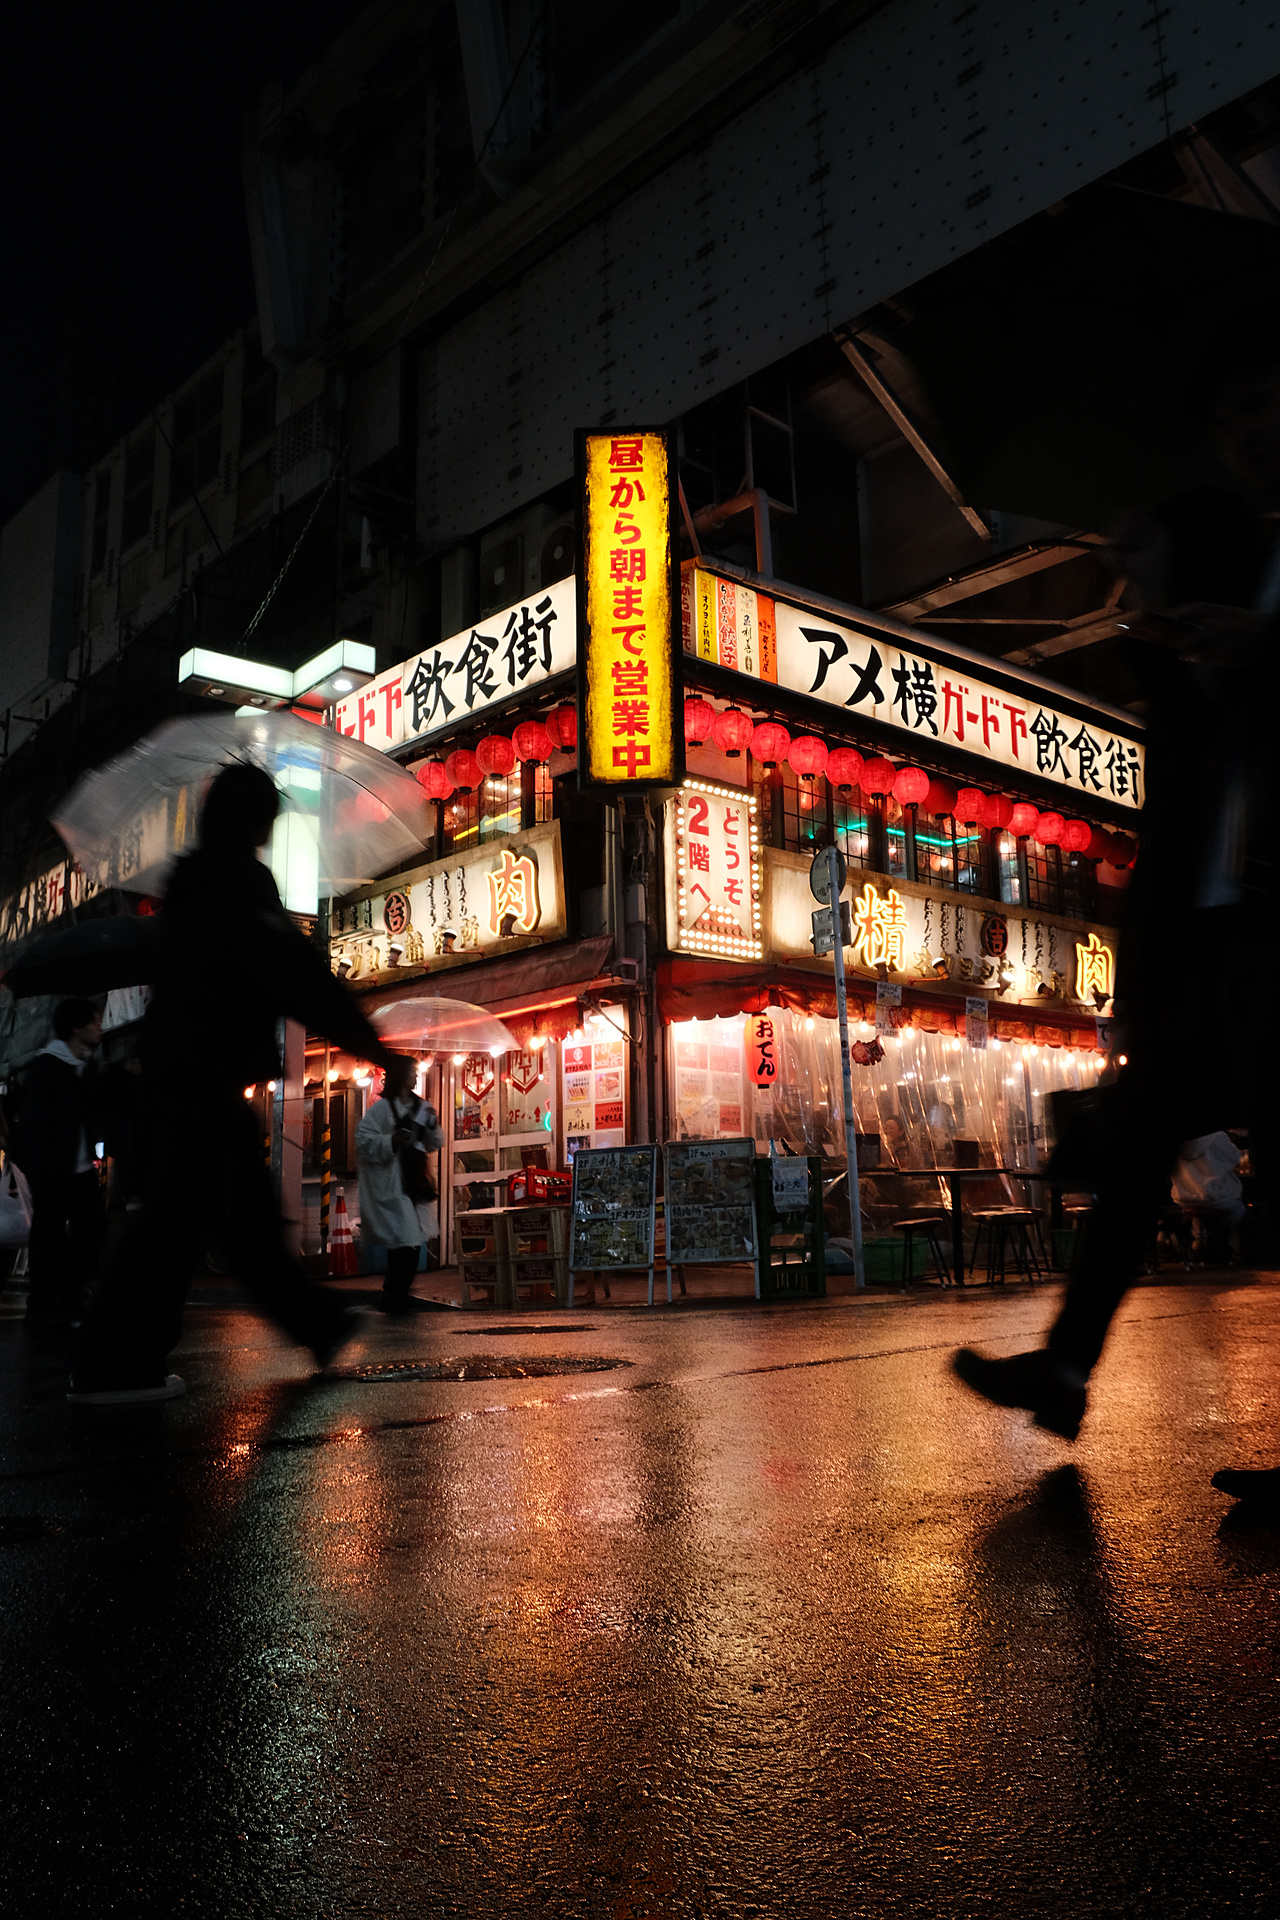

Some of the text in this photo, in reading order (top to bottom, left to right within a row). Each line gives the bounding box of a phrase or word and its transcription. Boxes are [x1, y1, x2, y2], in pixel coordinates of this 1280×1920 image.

[608, 439, 651, 778] 昼から朝まで営業中
[798, 626, 1141, 805] アメ横ガード下飲食街
[484, 850, 539, 937] 肉
[687, 795, 711, 903] 2階へ
[723, 807, 743, 906] どうぞ
[852, 884, 909, 972] 精
[1075, 933, 1113, 1000] 肉
[756, 1019, 775, 1076] おでん
